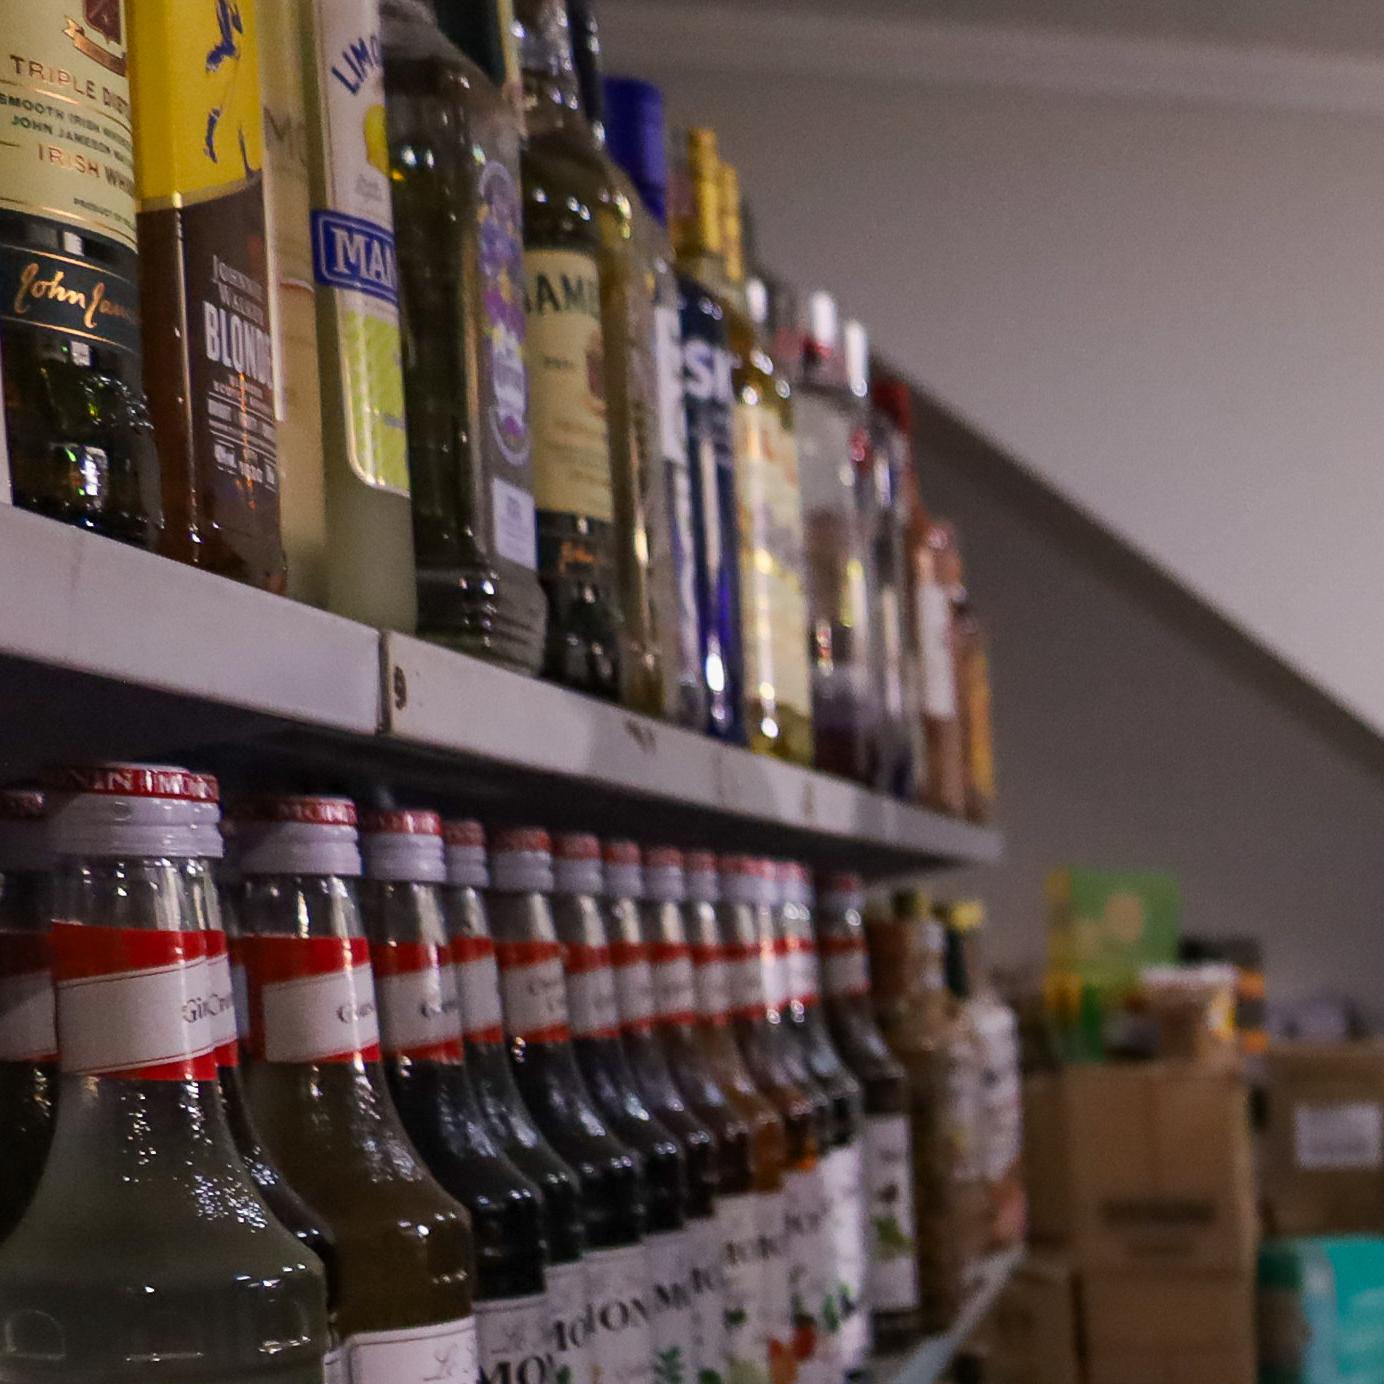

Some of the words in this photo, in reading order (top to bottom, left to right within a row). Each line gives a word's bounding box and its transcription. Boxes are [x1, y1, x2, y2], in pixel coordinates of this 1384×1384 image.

[10, 54, 97, 101] TRIPLE
[0, 92, 64, 120] SMOOTH
[12, 115, 53, 135] JOHN
[38, 143, 101, 178] IRISH
[14, 263, 86, 315] John
